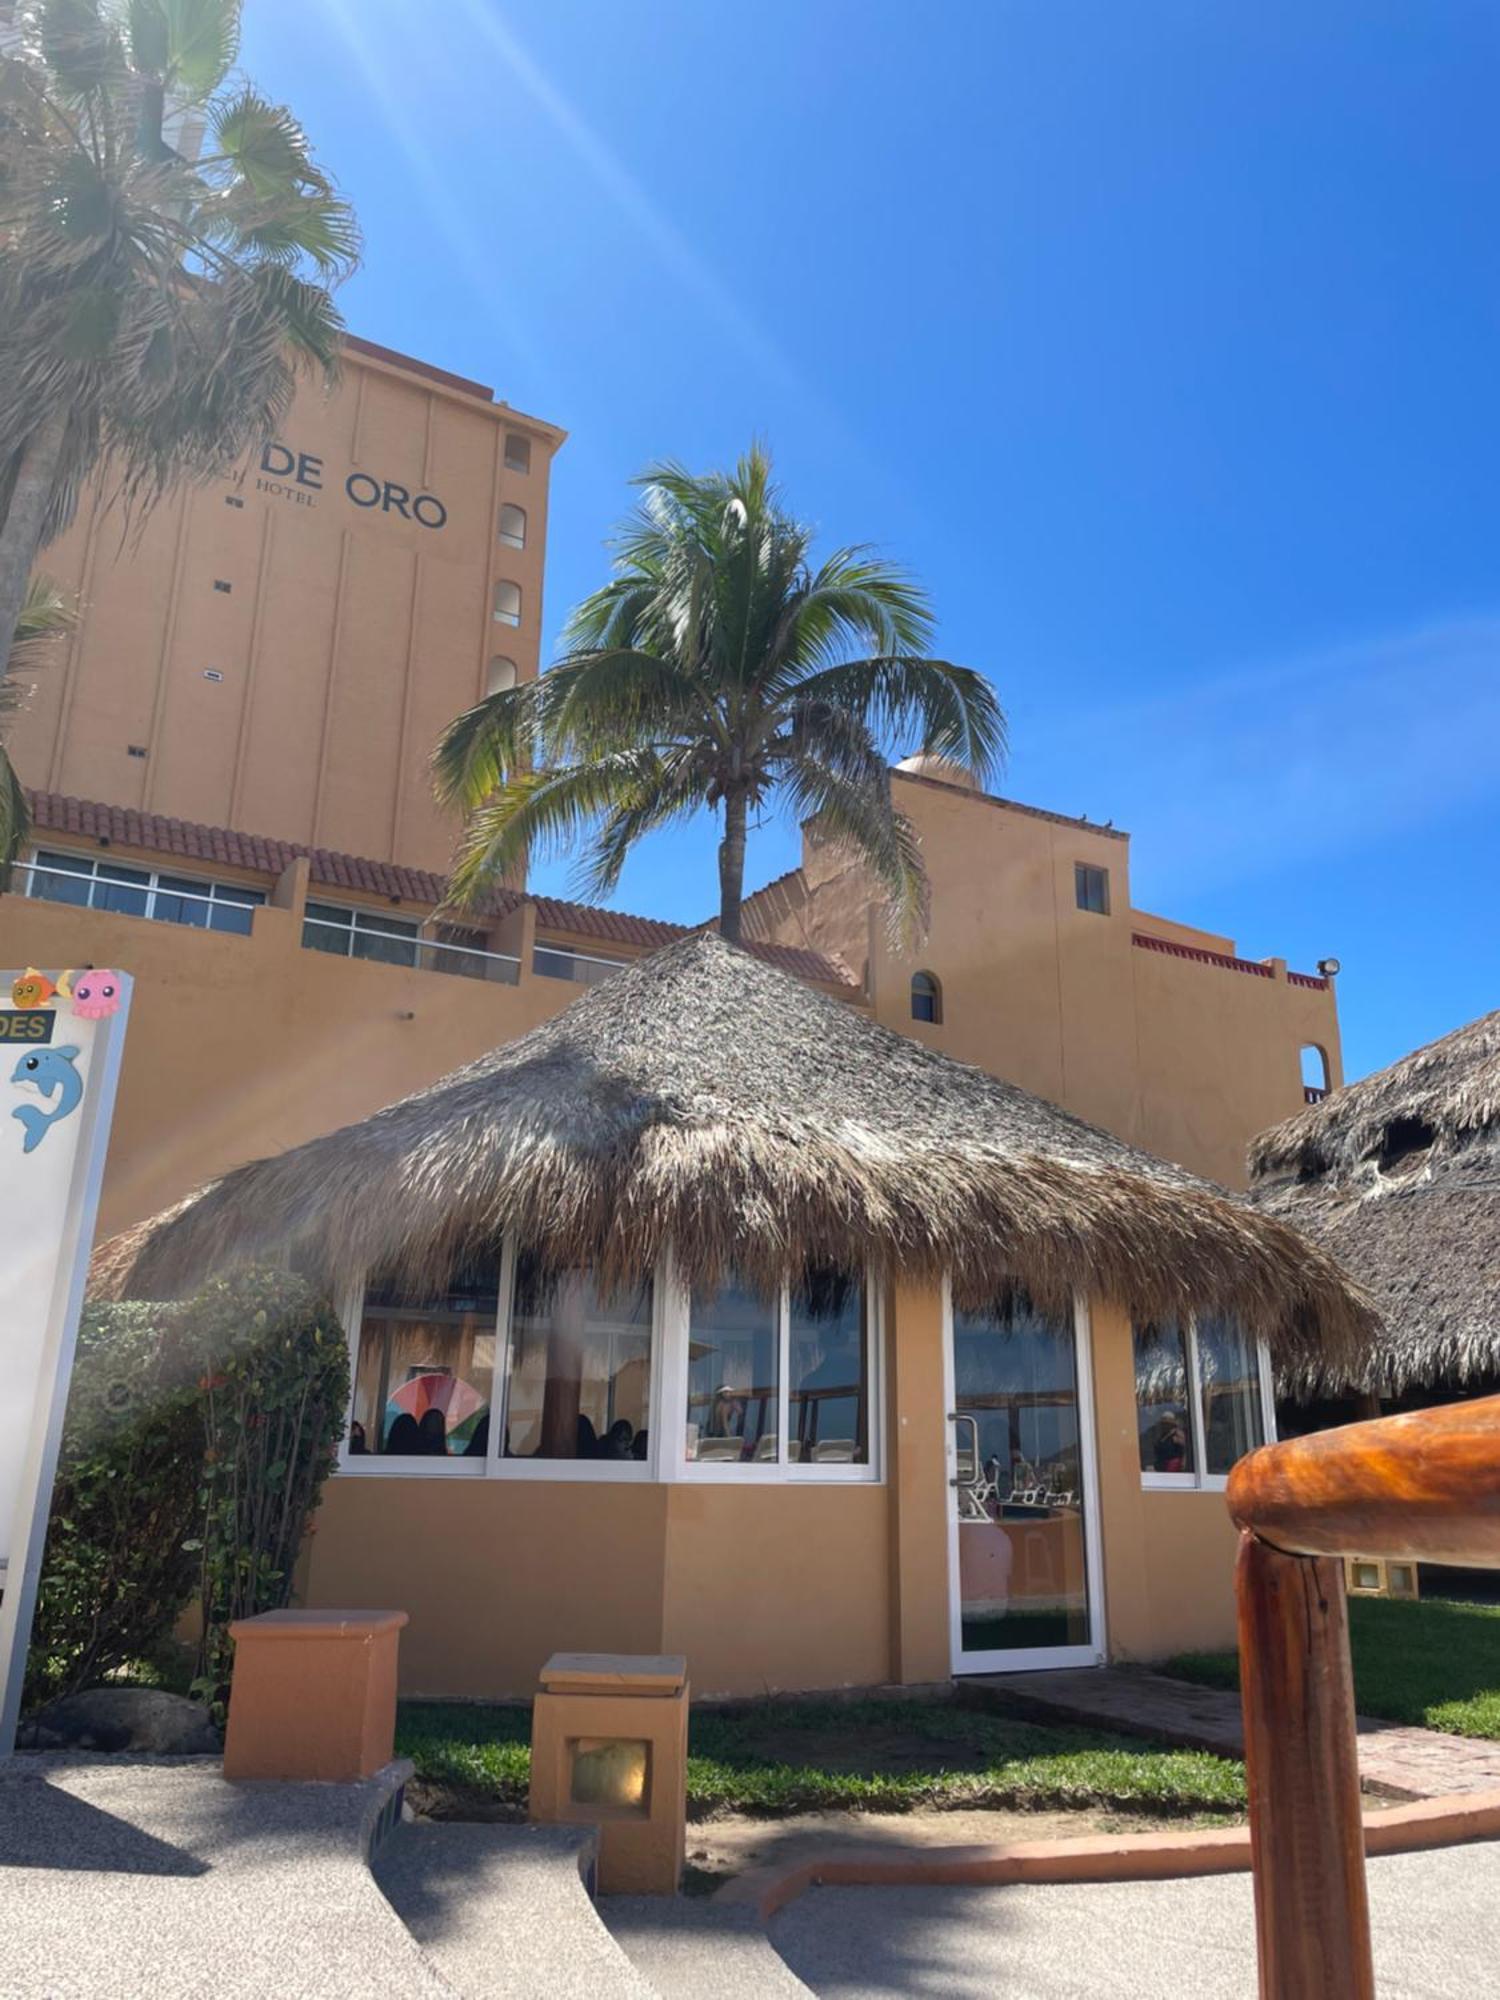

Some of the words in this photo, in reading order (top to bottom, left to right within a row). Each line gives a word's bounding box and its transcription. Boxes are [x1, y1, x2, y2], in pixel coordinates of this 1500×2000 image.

[256, 478, 318, 508] HOTEL
[260, 441, 324, 490] DE
[345, 473, 448, 529] ORO
